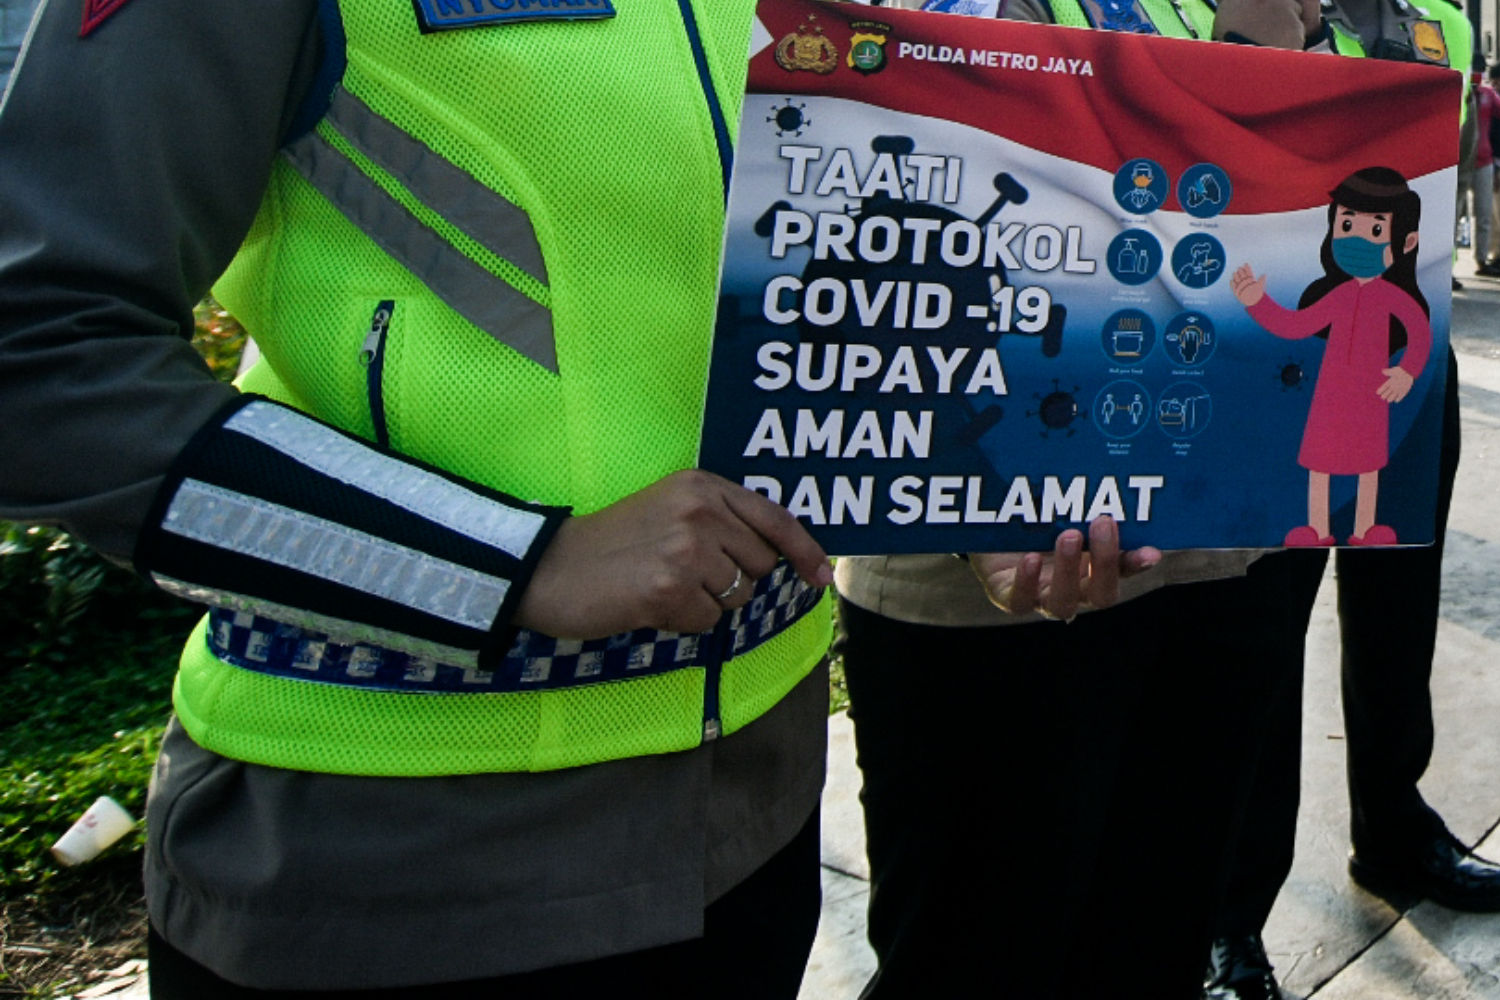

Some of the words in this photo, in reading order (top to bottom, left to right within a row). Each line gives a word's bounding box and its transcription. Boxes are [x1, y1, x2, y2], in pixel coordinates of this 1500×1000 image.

[898, 41, 966, 65] POLDA
[969, 49, 1038, 72] METRO
[1041, 56, 1094, 77] JAYA
[779, 144, 963, 204] TAATI
[770, 209, 1097, 274] PROTOKOL
[762, 274, 953, 330] COVID
[753, 340, 1009, 396] SUPAYA
[742, 407, 934, 459] AMAN
[886, 475, 1165, 526] SELAMAT
